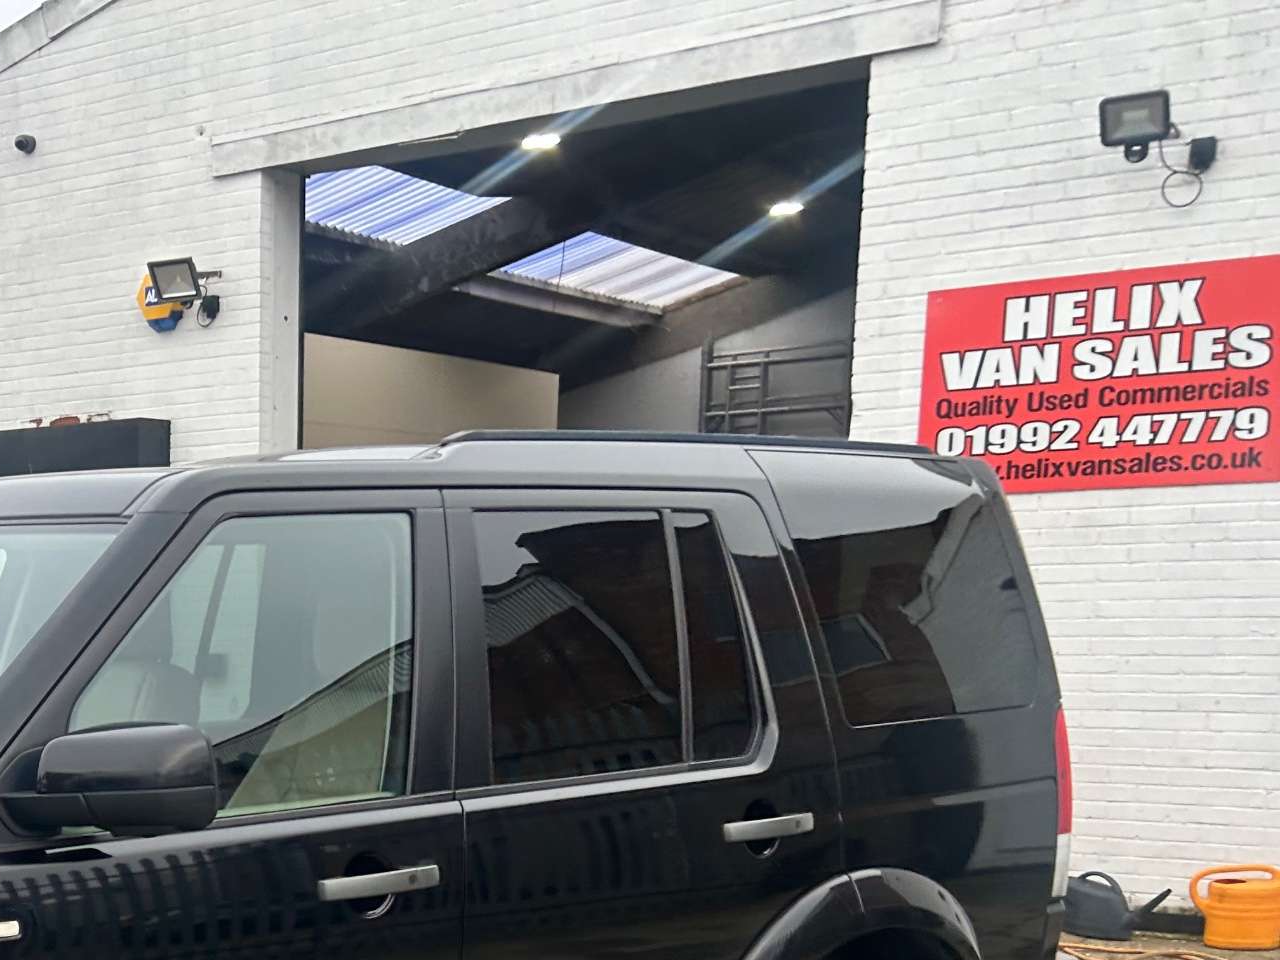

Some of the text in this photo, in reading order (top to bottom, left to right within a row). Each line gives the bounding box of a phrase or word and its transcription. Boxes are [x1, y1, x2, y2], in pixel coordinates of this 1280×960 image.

[1002, 277, 1206, 343] HELIX
[939, 323, 1273, 392] VAN SALES
[935, 376, 1270, 420] Quality Used Commercials
[935, 405, 1271, 458] 01992 447779
